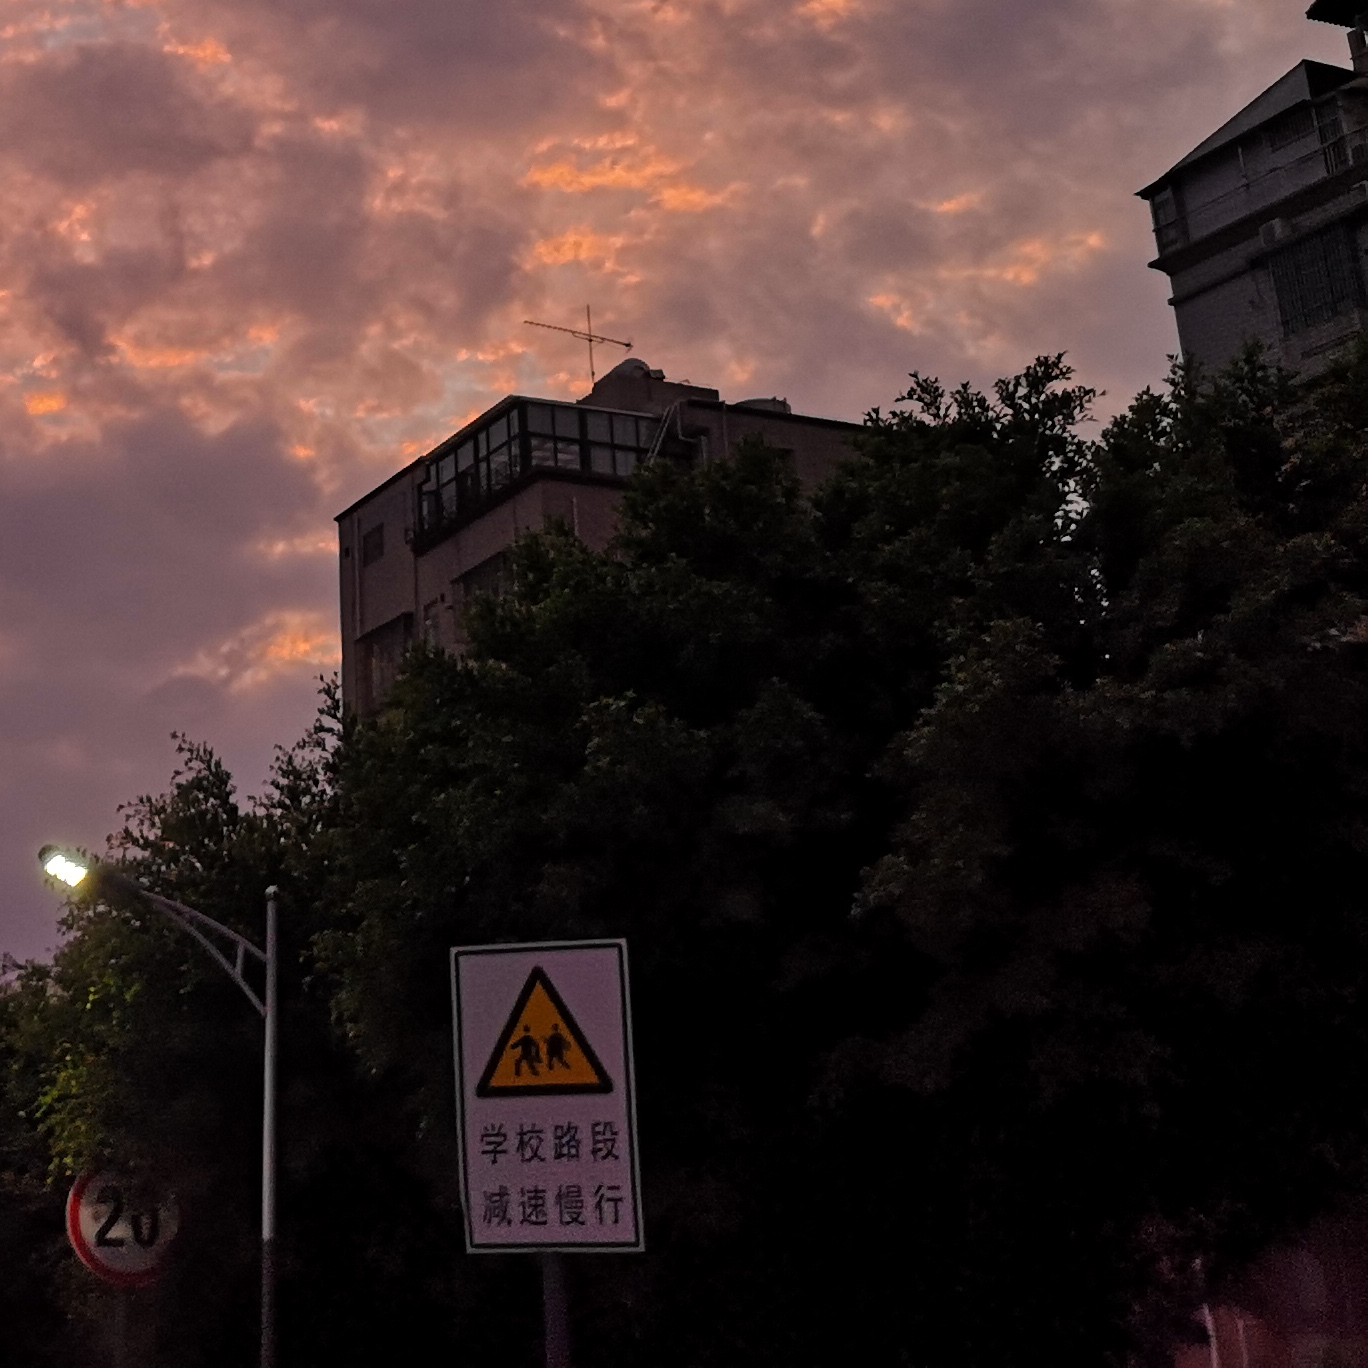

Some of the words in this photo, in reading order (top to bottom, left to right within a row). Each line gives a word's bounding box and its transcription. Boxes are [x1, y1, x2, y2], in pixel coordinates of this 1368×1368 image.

[480, 1120, 621, 1164] 学校路段
[93, 1183, 160, 1250] 20
[482, 1183, 624, 1228] 减速慢行
